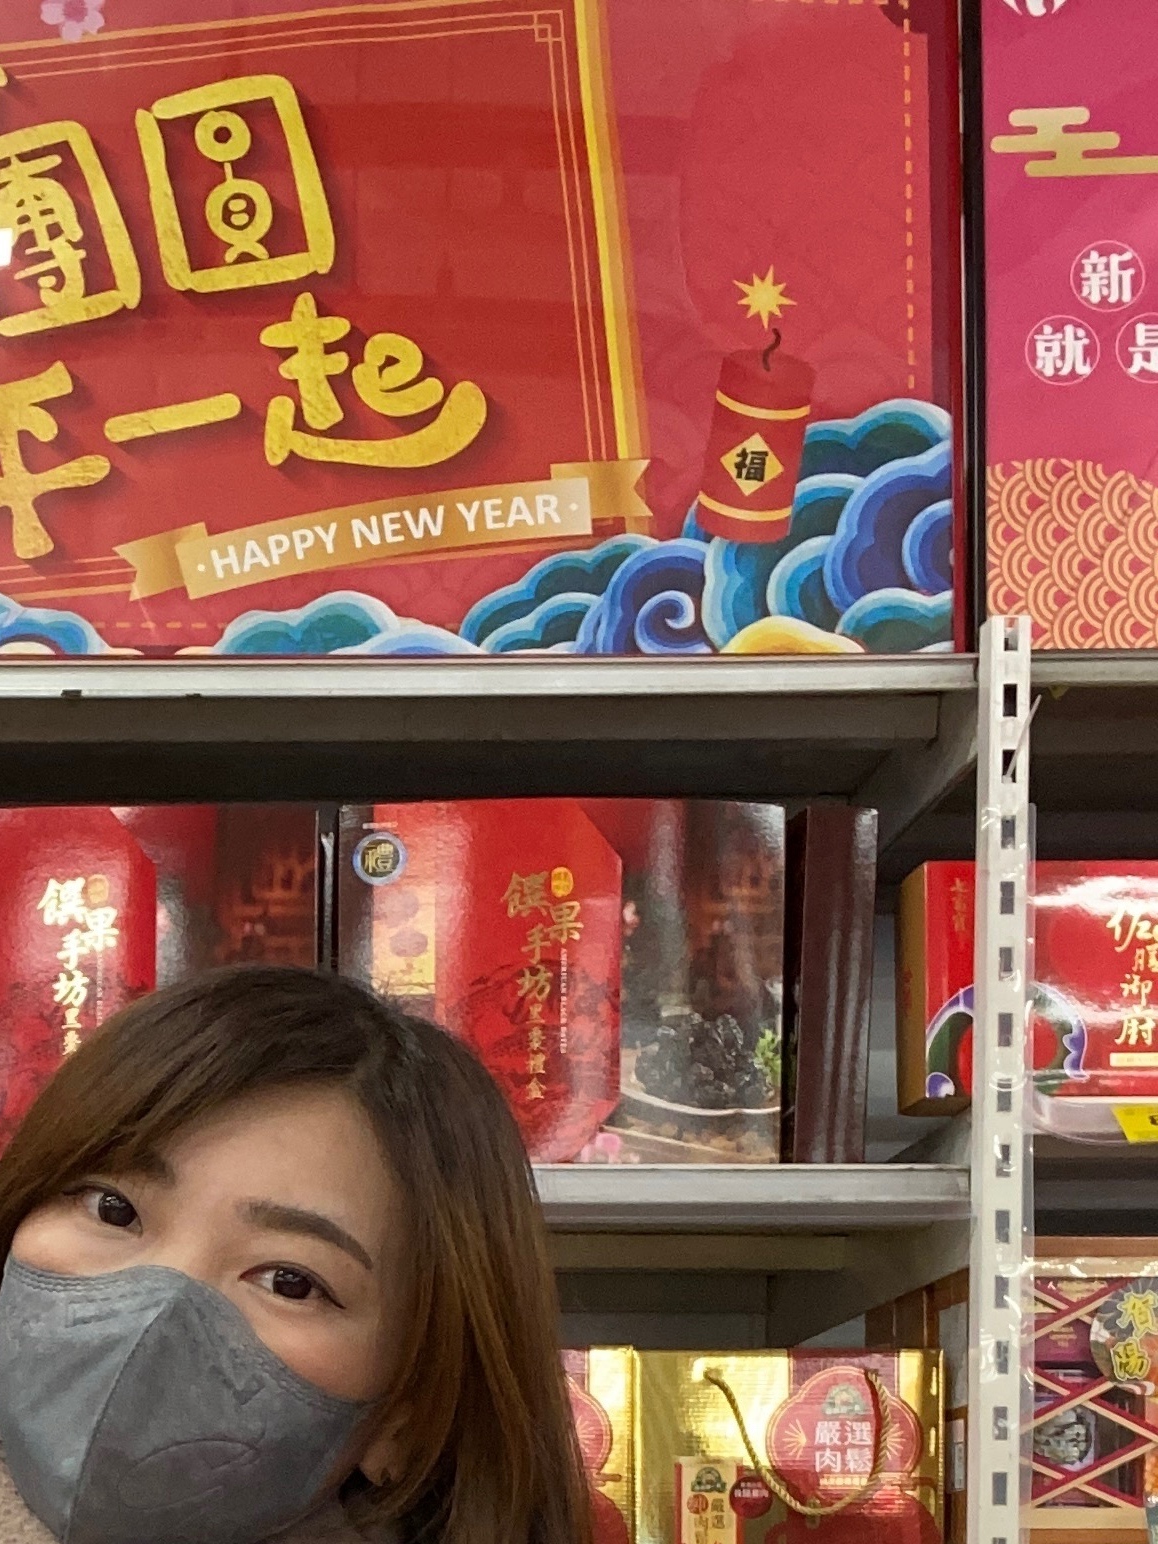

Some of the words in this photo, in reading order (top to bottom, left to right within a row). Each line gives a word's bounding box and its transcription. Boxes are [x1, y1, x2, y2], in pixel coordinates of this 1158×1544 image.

[1080, 250, 1135, 305] 新
[733, 448, 770, 484] 福
[210, 521, 338, 581] HAPPY
[349, 504, 445, 549] NEW
[455, 496, 561, 532] YEAR
[814, 1420, 873, 1446] 嚴選
[814, 1448, 872, 1473] 肉鬆
